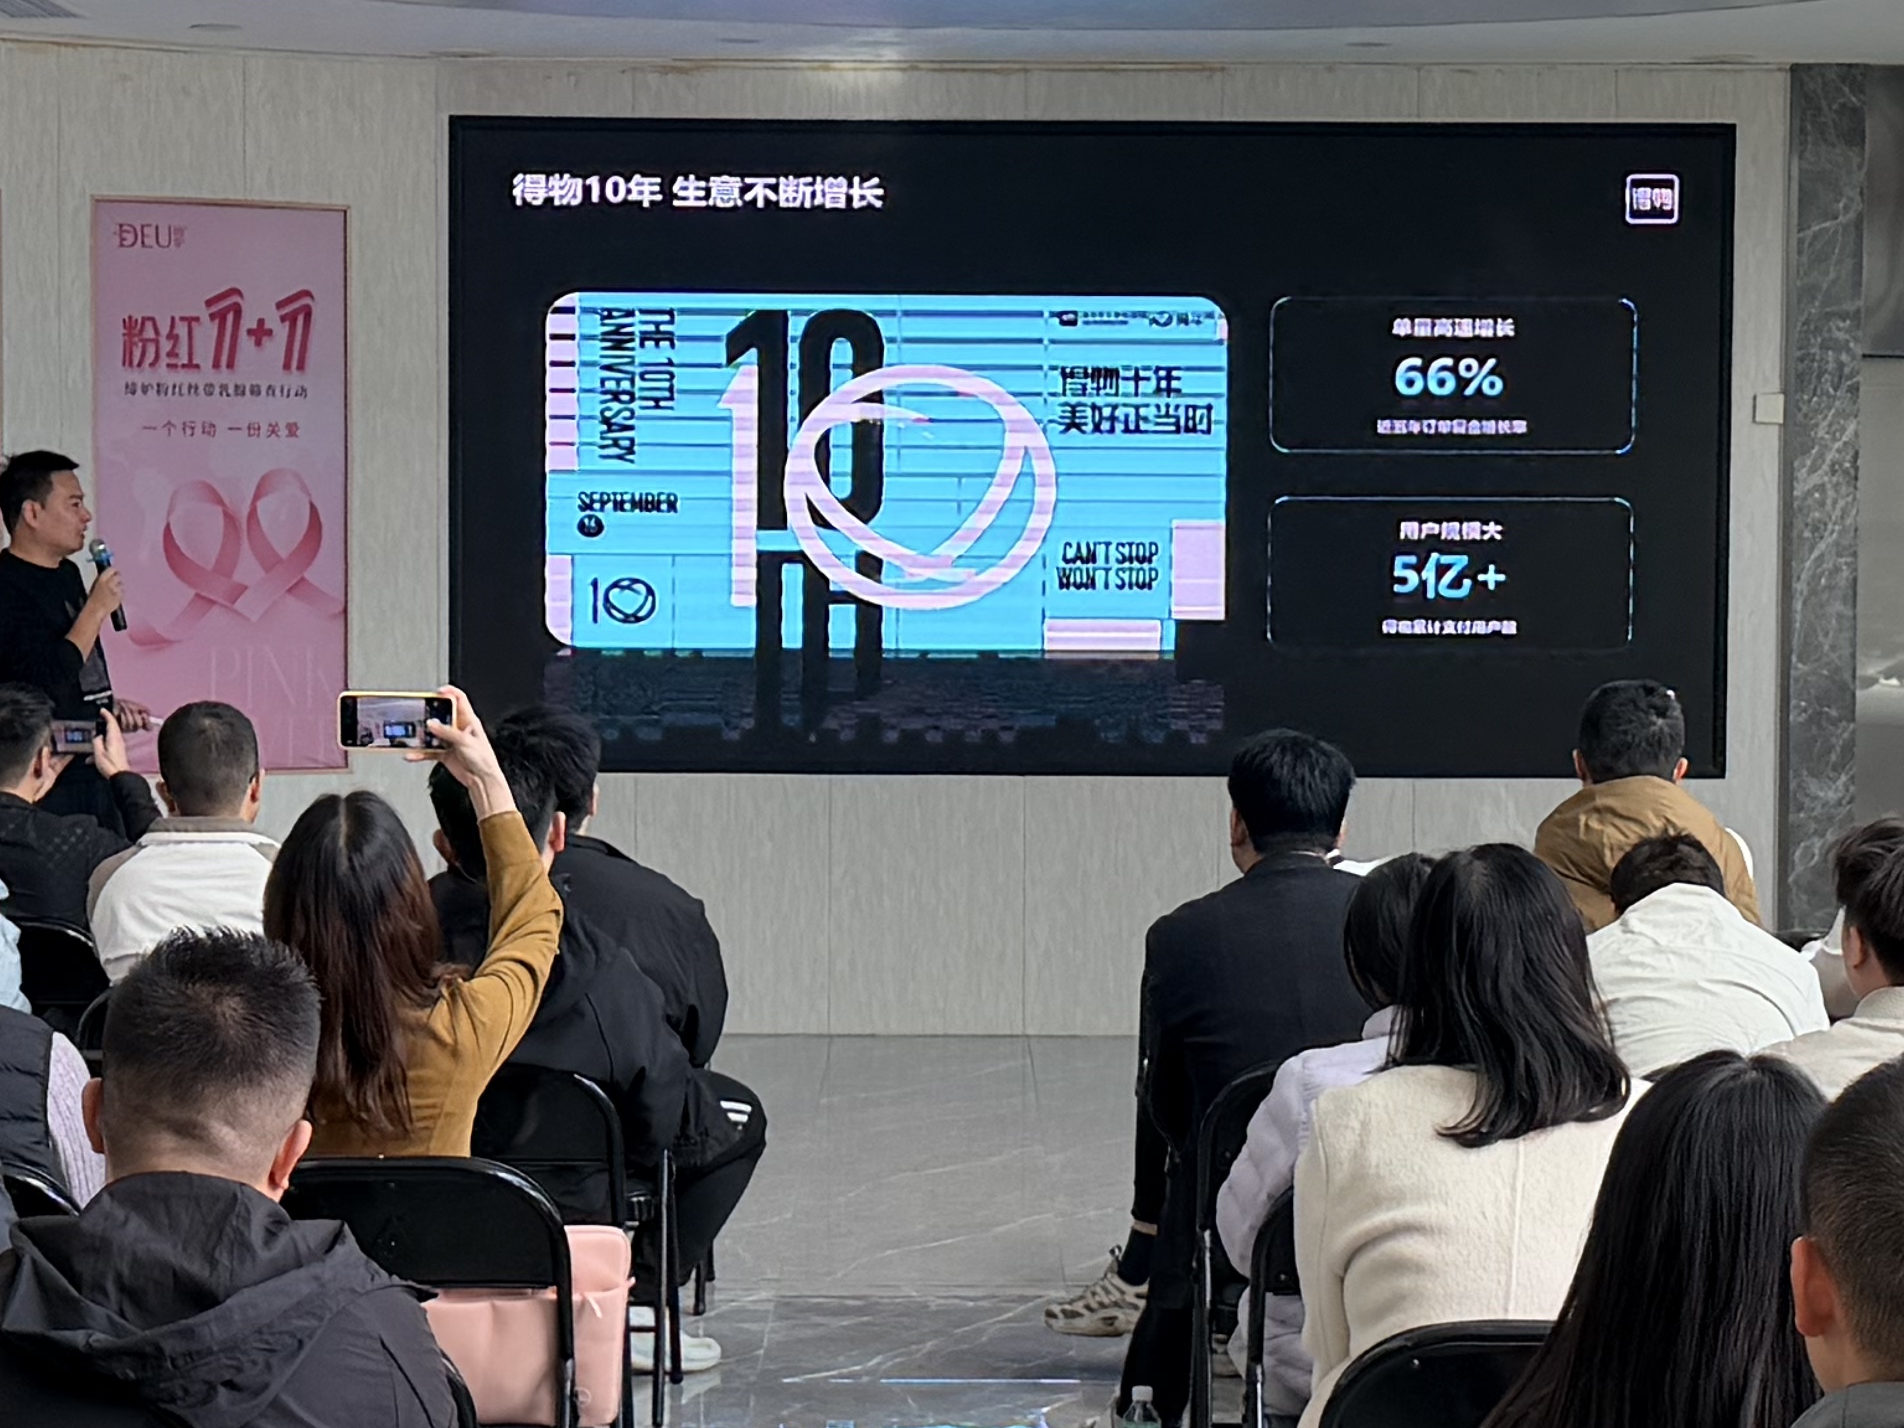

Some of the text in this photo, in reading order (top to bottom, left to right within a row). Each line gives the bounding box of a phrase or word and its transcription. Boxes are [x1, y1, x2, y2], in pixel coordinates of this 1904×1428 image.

[512, 173, 885, 209] 得物10年 生意不断增长
[638, 308, 676, 350] THE
[598, 308, 636, 464] ANNIVERSARY
[1395, 357, 1504, 397] 66%
[1057, 402, 1214, 435] 美好正当时
[578, 491, 678, 513] SEPTEMBER
[1115, 541, 1159, 564] STOP
[1115, 567, 1159, 590] STOP
[1393, 552, 1506, 599] 5亿+
